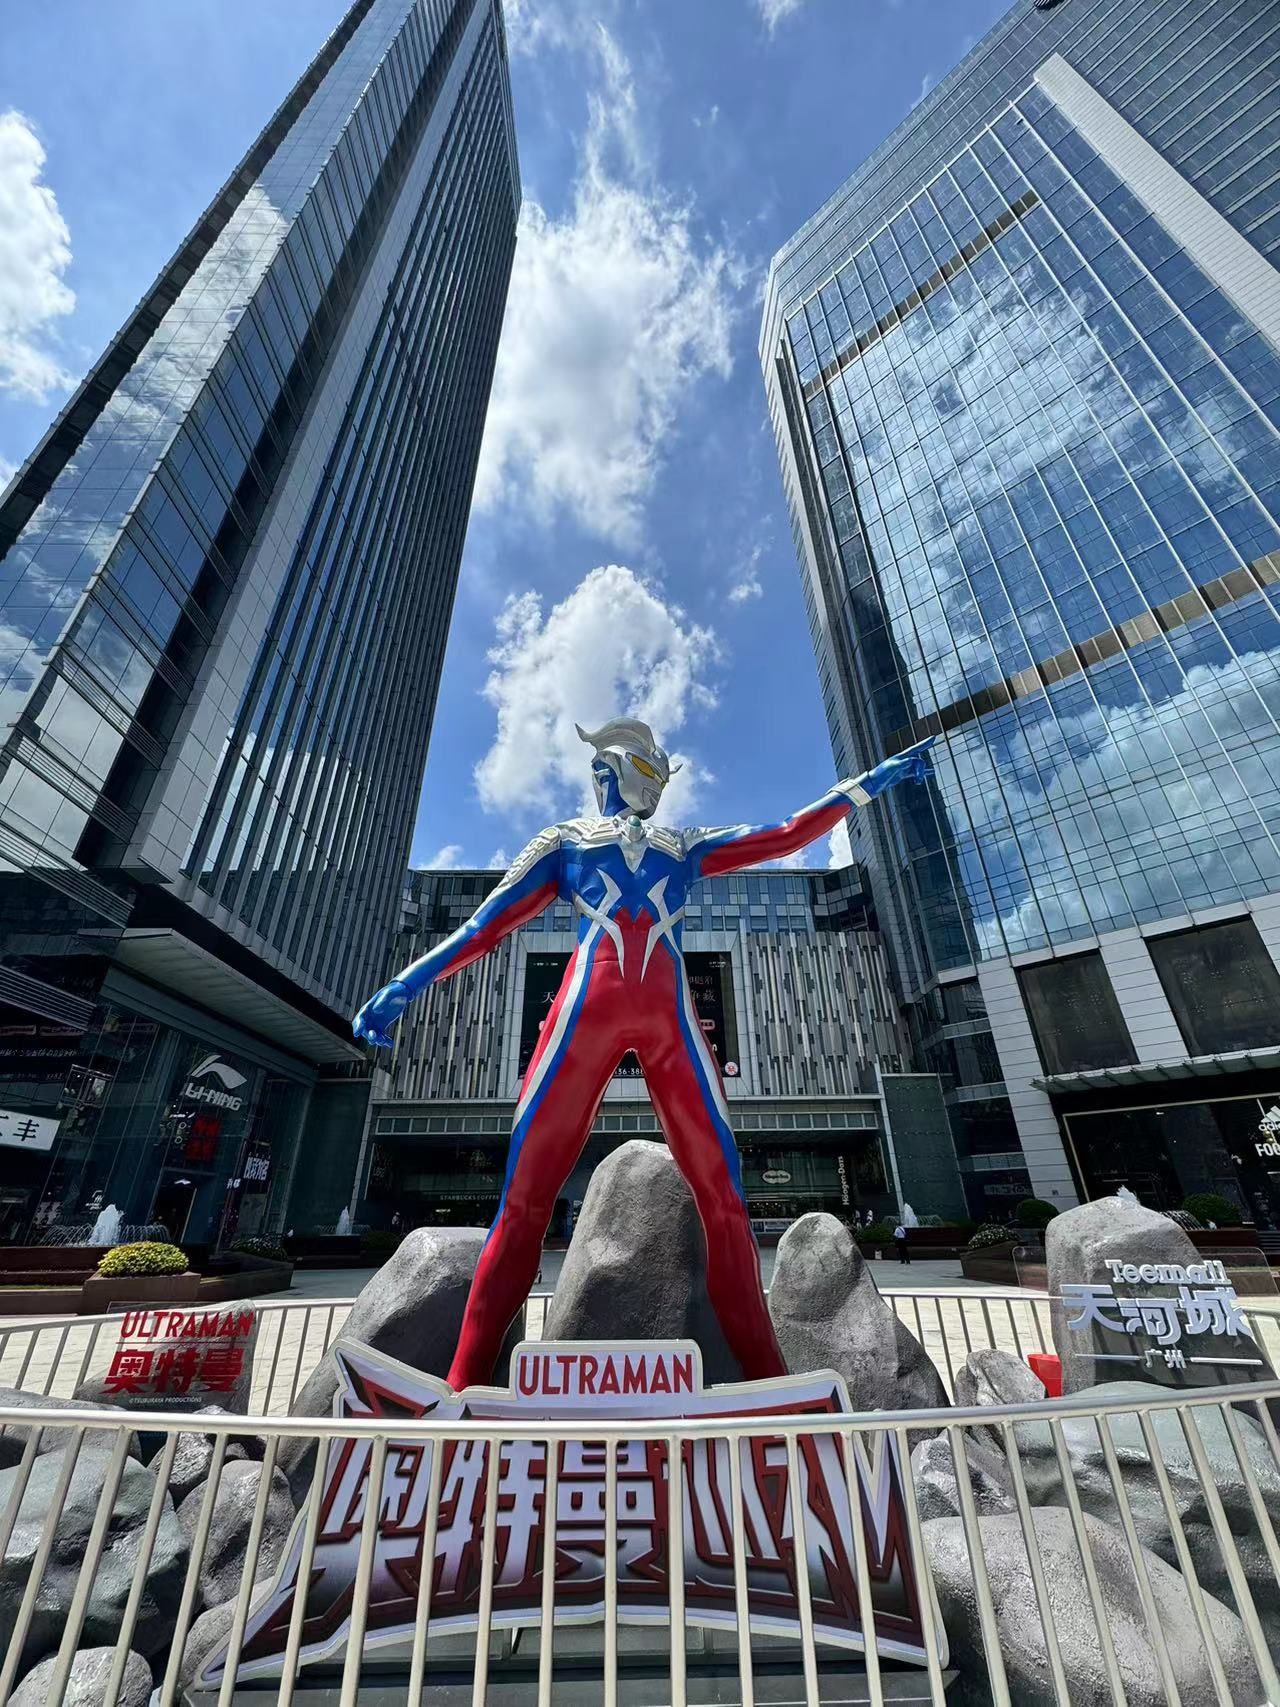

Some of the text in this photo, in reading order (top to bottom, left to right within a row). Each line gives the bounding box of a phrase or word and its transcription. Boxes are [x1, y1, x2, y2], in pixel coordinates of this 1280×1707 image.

[1104, 1259, 1232, 1285] Teemall
[120, 1312, 254, 1338] ULTRAMAN
[1059, 1284, 1254, 1346] 天河城
[98, 1348, 245, 1394] 奥特曼
[518, 1353, 694, 1396] ULTRAMAN
[1144, 1348, 1187, 1369] 广州
